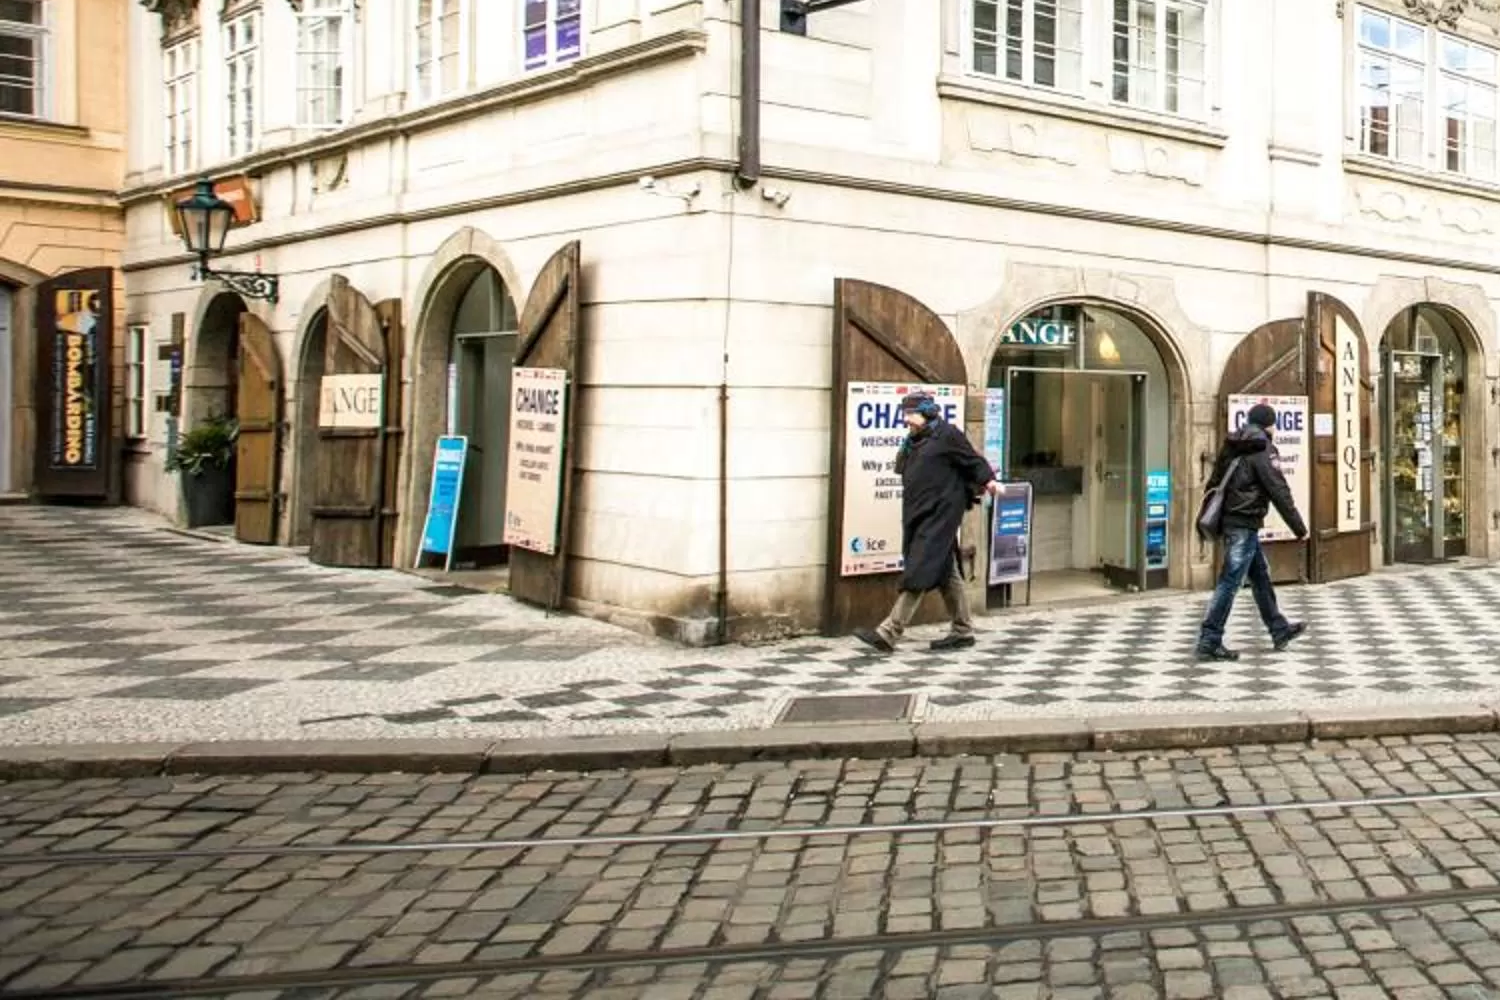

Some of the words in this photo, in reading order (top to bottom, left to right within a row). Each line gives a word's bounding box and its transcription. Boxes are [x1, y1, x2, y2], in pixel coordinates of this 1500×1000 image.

[65, 335, 82, 464] BOMBARDINO
[515, 387, 559, 415] CHANGE
[857, 402, 957, 429] CHAE
[1235, 411, 1303, 430] CNGE
[1343, 341, 1357, 520] ANTIQUE
[866, 537, 887, 550] ice
